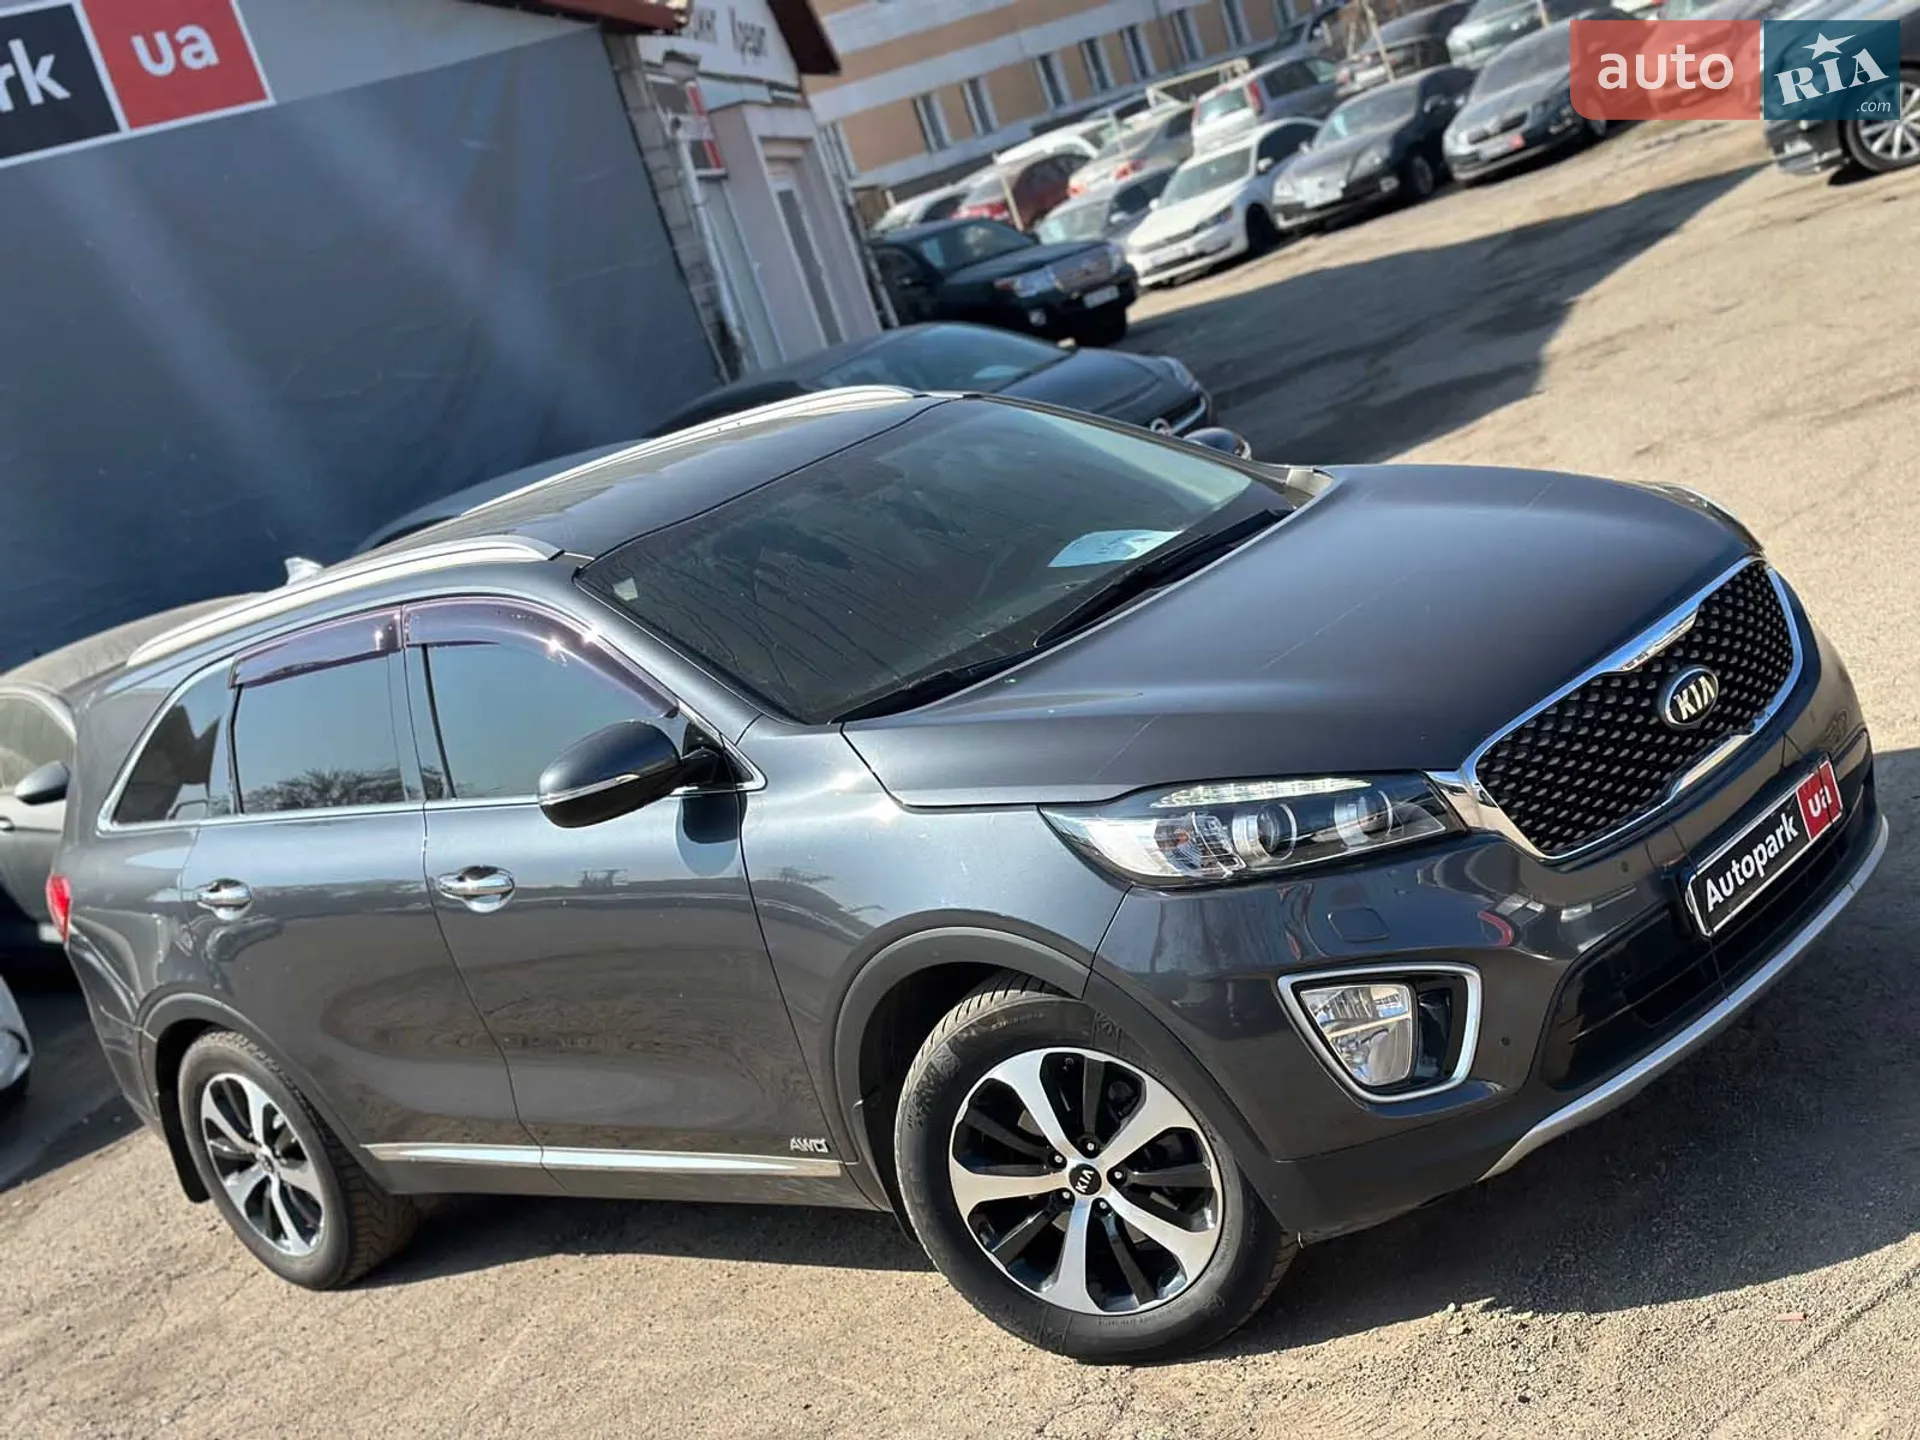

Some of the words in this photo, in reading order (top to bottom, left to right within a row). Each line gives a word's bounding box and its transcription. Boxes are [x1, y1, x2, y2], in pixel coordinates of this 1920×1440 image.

[130, 24, 220, 77] ua
[1673, 675, 1716, 721] KIA
[1704, 811, 1799, 913] Autopark
[1807, 784, 1833, 818] ua
[1075, 1169, 1095, 1193] KIA
